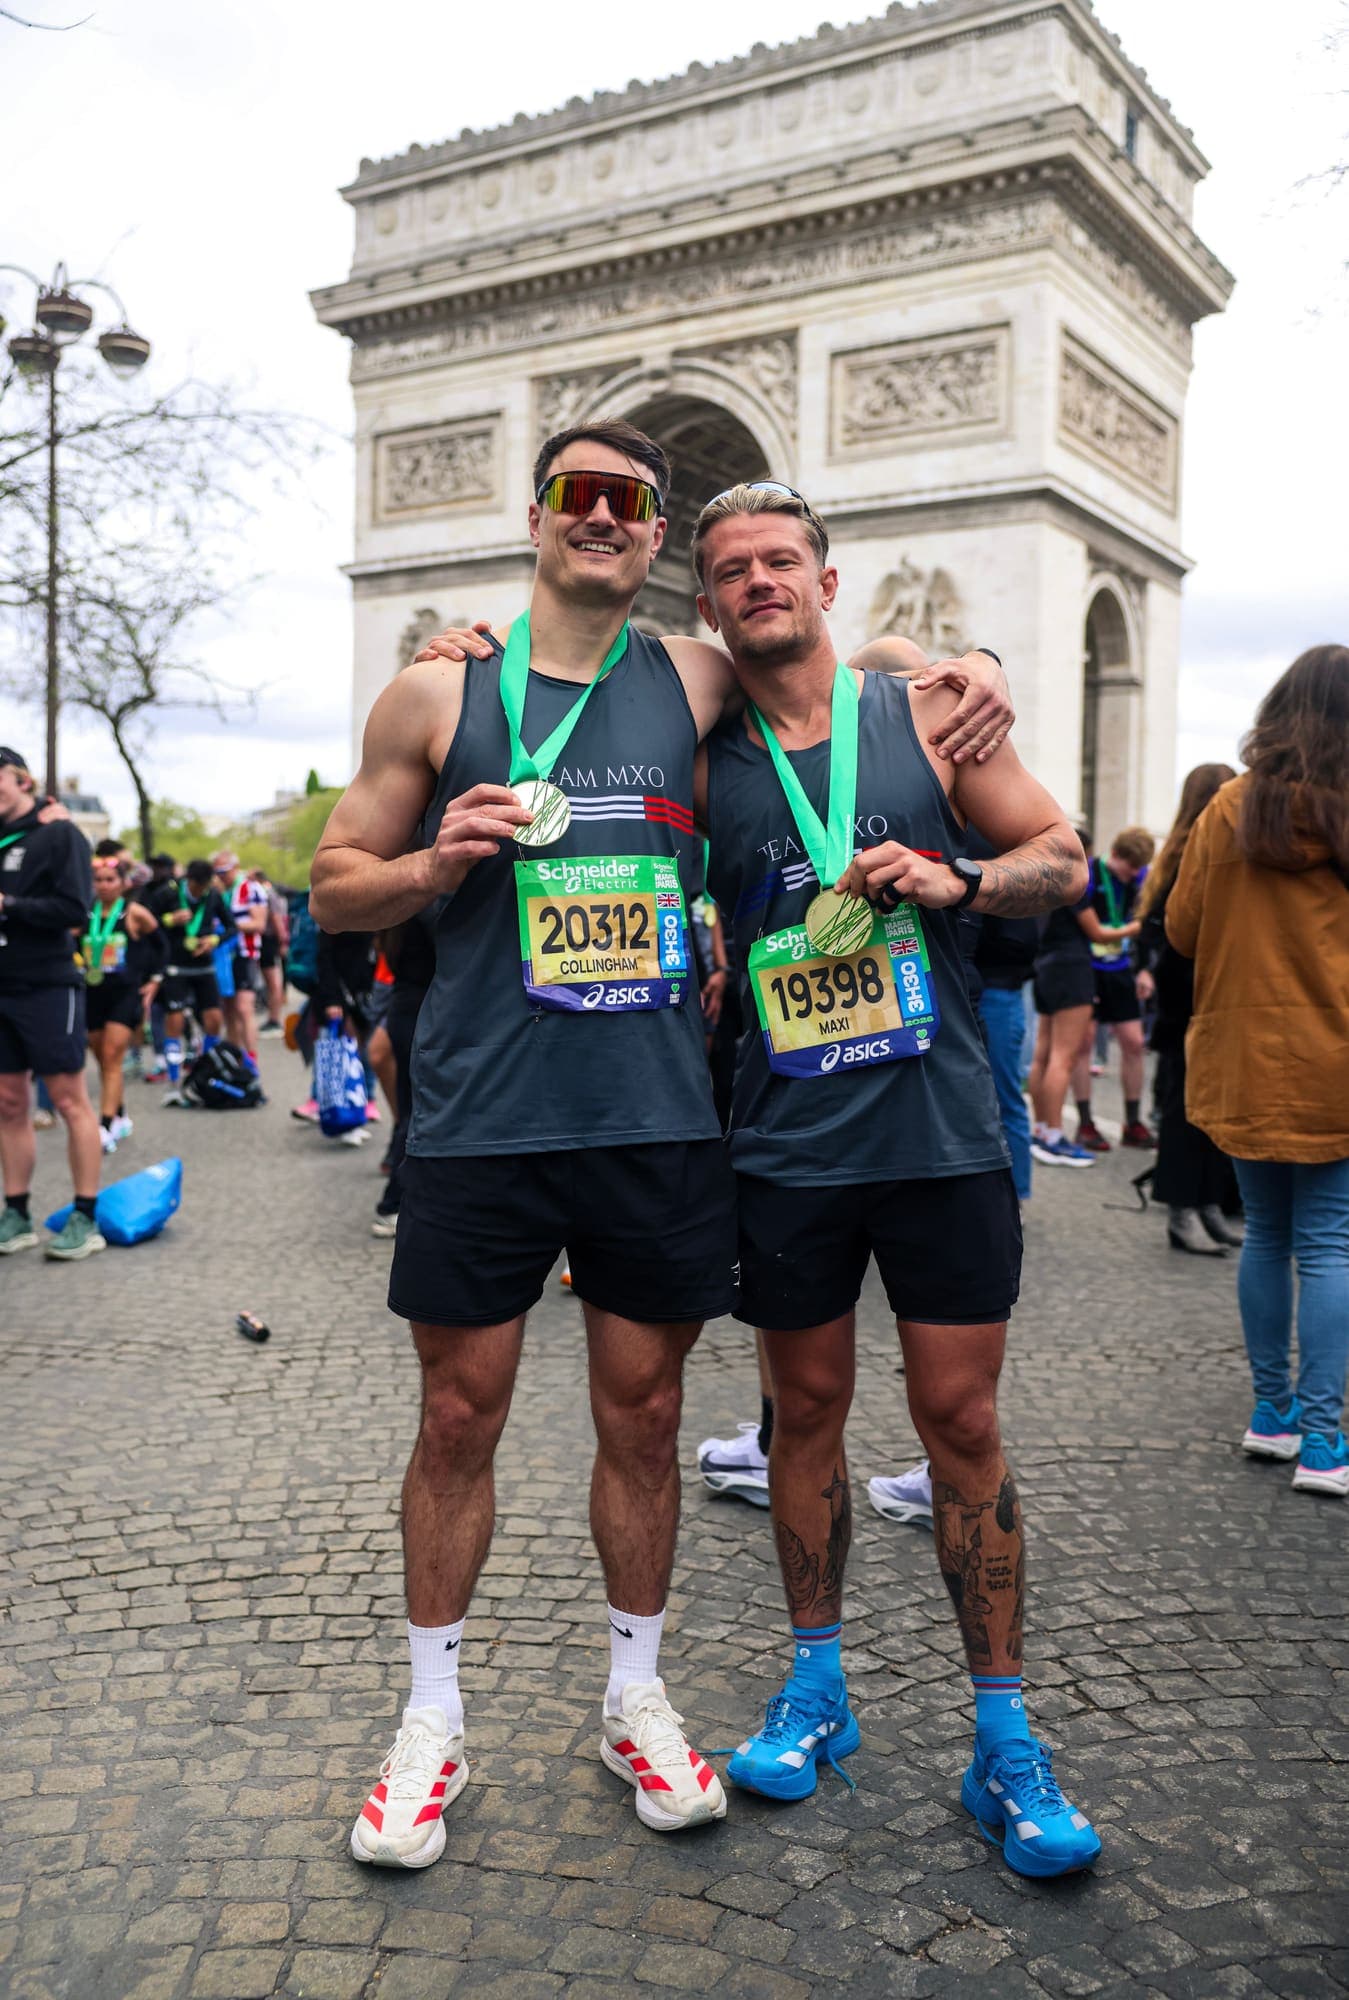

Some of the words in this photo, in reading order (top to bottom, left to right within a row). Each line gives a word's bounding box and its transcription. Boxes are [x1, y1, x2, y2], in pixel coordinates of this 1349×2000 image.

[548, 766, 599, 788] AM
[605, 765, 665, 788] MXO
[757, 835, 803, 862] TEA
[853, 815, 888, 838] XO
[537, 860, 640, 880] Schneider
[584, 878, 639, 890] Electric
[539, 902, 650, 954] 20312
[888, 923, 915, 937] PARIS
[664, 915, 681, 966] 3H30
[560, 958, 638, 975] COLLINGHAM
[605, 987, 650, 1005] asics
[771, 957, 884, 1021] 19398
[900, 961, 925, 1013] 3H30
[819, 1017, 850, 1035] MAXI
[842, 1038, 890, 1063] asics
